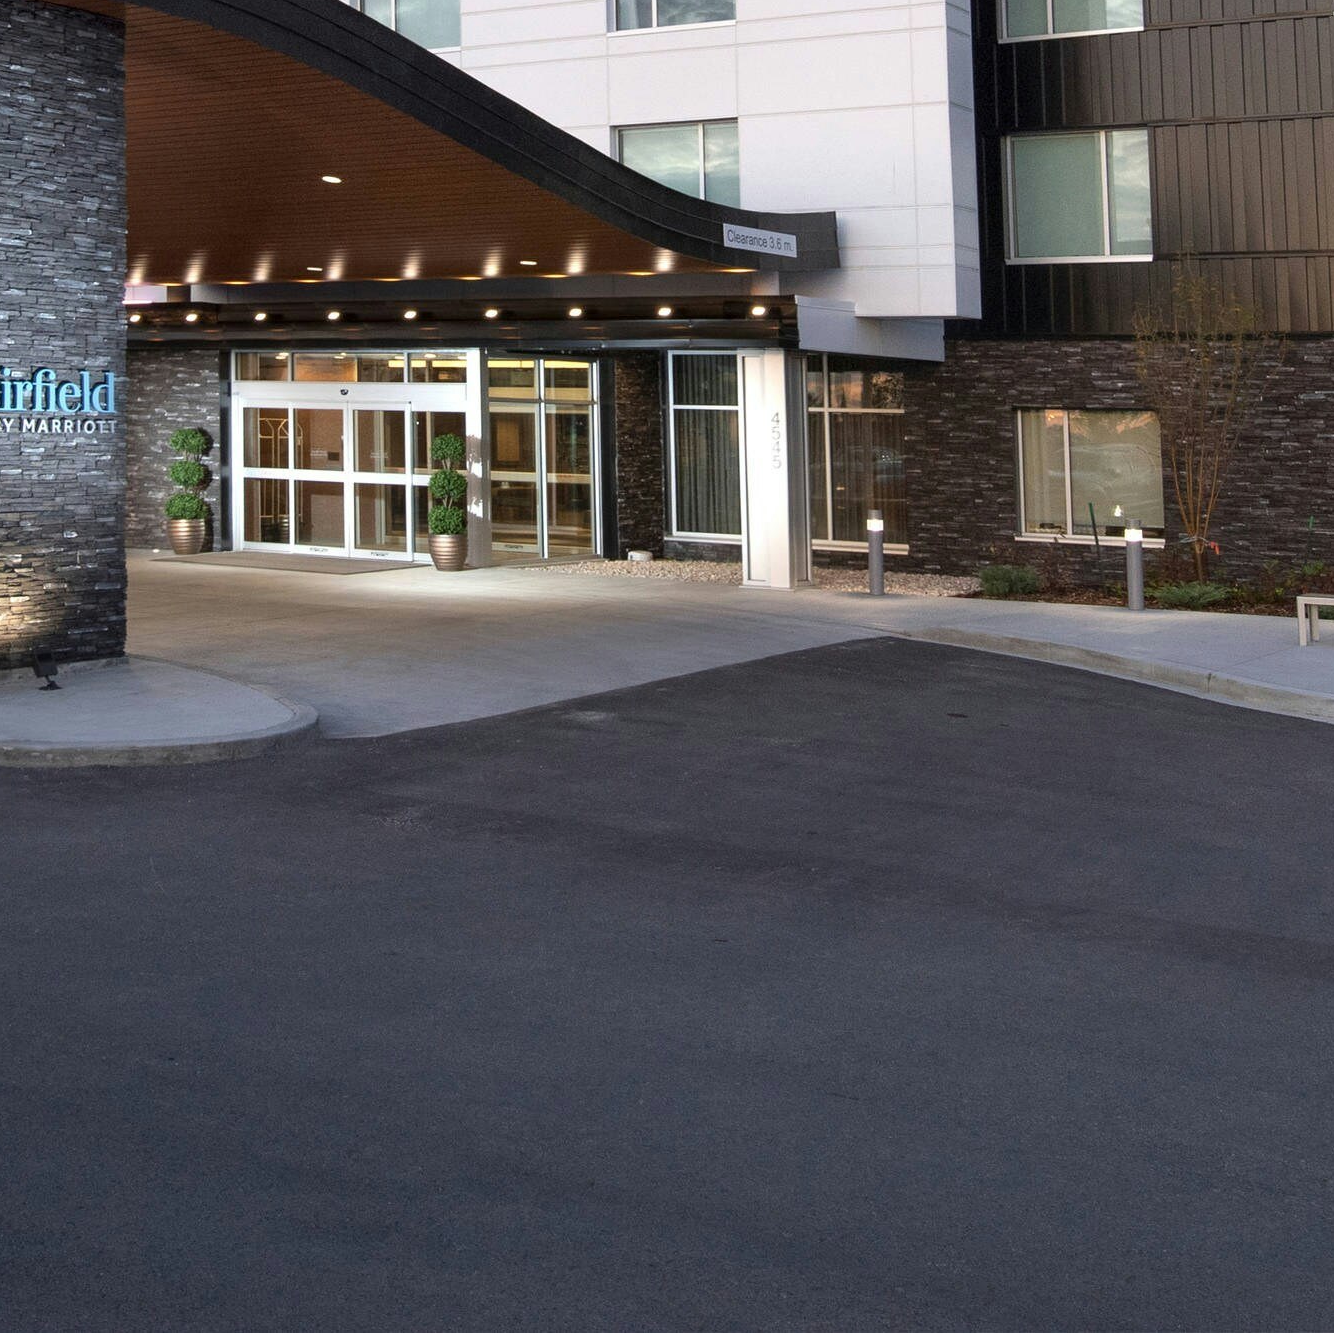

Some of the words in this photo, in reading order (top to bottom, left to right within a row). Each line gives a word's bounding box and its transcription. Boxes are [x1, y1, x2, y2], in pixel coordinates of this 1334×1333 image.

[727, 229, 767, 248] Clearance
[769, 236, 782, 250] 3.6
[21, 419, 116, 434] MARRIOTT
